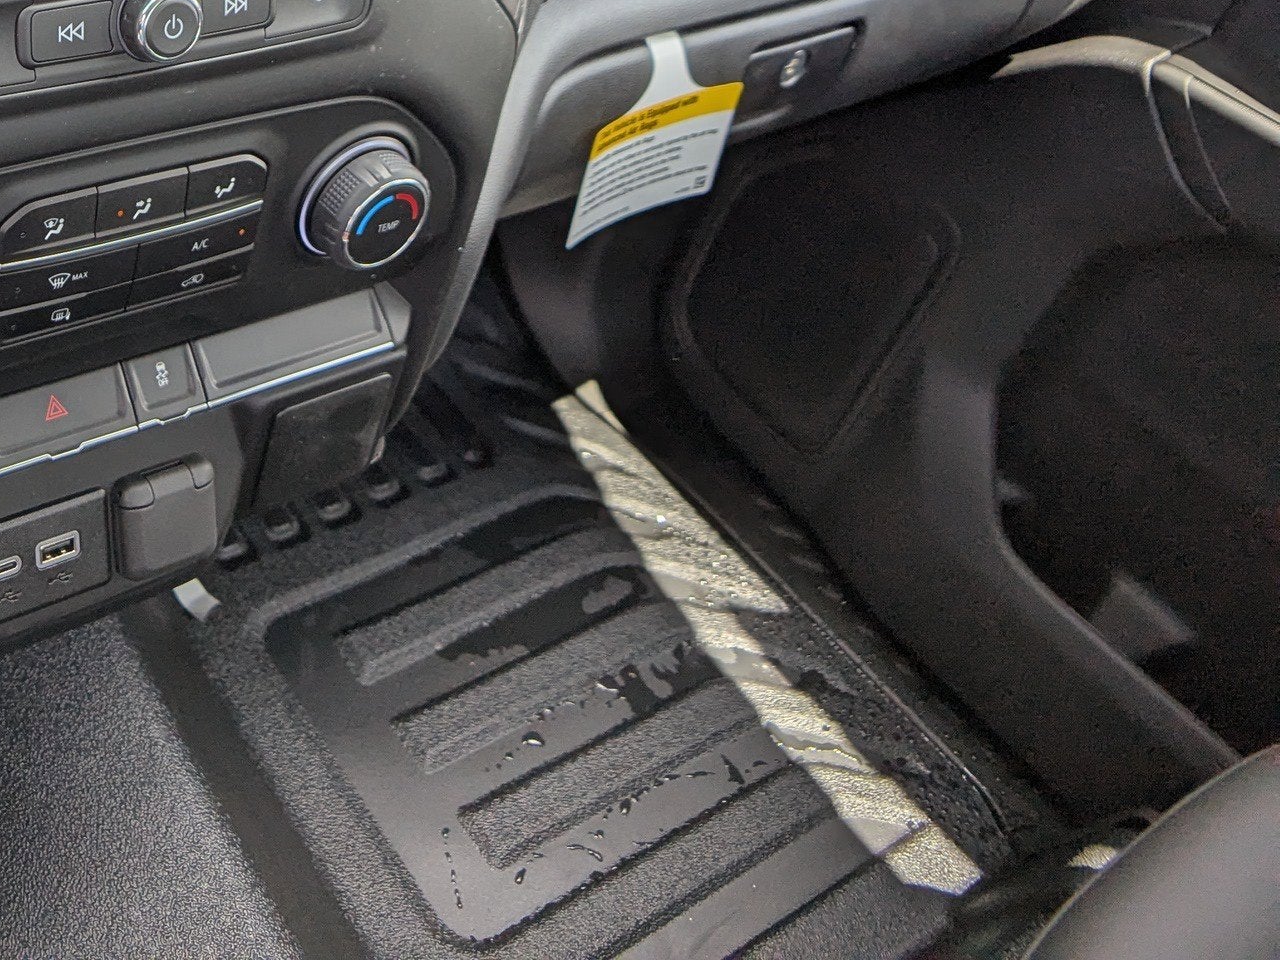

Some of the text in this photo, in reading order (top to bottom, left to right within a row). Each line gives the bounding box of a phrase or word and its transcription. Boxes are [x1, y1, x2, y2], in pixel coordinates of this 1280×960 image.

[378, 220, 400, 233] TEMP
[191, 238, 210, 252] A/C
[72, 271, 89, 281] MAX
